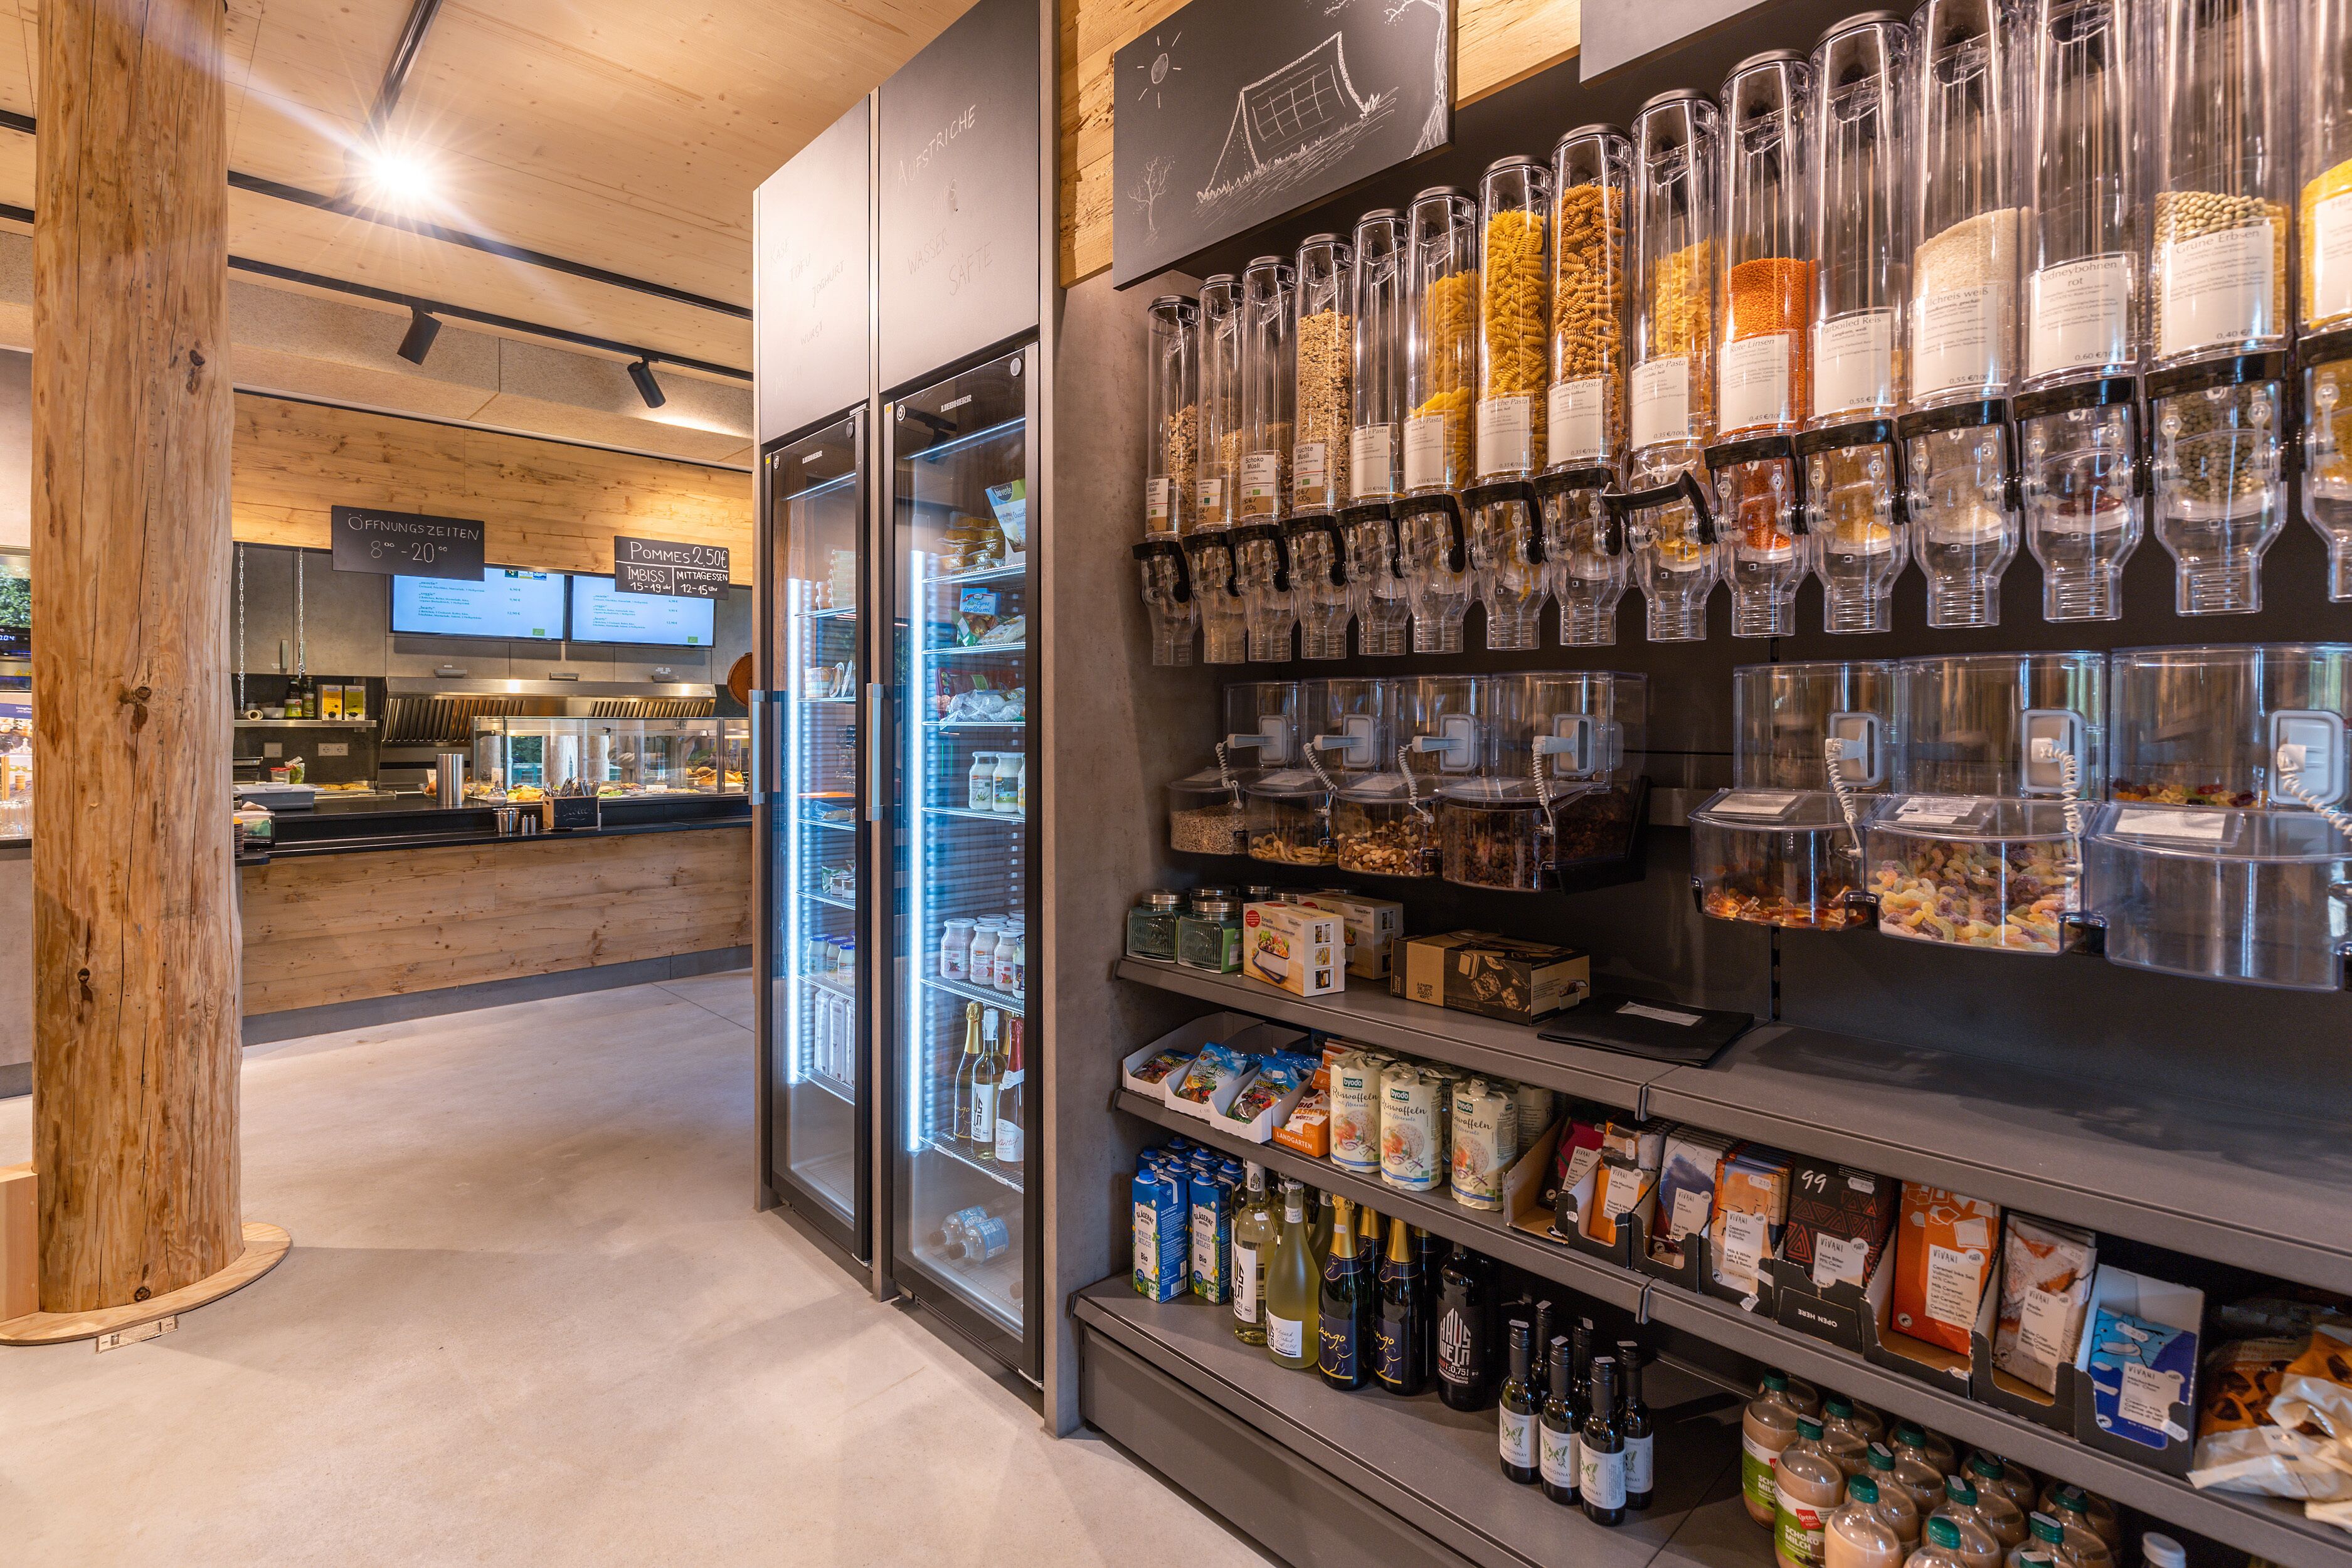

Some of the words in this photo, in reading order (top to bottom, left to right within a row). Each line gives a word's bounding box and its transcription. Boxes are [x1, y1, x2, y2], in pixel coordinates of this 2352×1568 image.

[2218, 230, 2260, 243] Erbsen
[907, 227, 949, 275] WASSER
[949, 241, 993, 296] SÄFTE
[812, 260, 845, 308] JOGHURT
[2068, 278, 2083, 286] rot
[1927, 292, 1961, 306] ilchreis
[1964, 287, 1988, 297] weiß
[1821, 318, 1859, 334] Parboiled
[1863, 316, 1881, 324] Reis
[800, 320, 823, 346] WURST
[1730, 344, 1746, 352] Rote
[1748, 339, 1774, 348] Linsen
[940, 395, 972, 413] LIEBHERR
[1296, 446, 1313, 454] Früchte
[802, 450, 822, 464] LIEBHERR
[348, 513, 479, 541] ÖFFNUNGSZEITEN
[630, 541, 690, 564] POMMES
[627, 566, 665, 583] IMBISS
[677, 571, 728, 581] MITTAGESSEN
[1343, 1078, 1362, 1088] byodo
[1332, 1086, 1379, 1103] Reiswaffeln
[1391, 1089, 1409, 1099] byodo
[1381, 1096, 1428, 1116] Reiswaffeln
[1457, 1101, 1473, 1112] byodo
[1276, 1131, 1312, 1150] LANDGARTEN
[1801, 1170, 1827, 1193] 99
[1136, 1210, 1155, 1224] GLÄSERNE
[1194, 1212, 1214, 1227] GLÄSERNE
[1138, 1229, 1152, 1240] WEIDE
[1729, 1225, 1751, 1234] Cappuccino
[1729, 1229, 1745, 1237] Vollmilch
[1138, 1237, 1152, 1248] MILCH
[1195, 1231, 1210, 1242] WEIDE
[1195, 1239, 1210, 1250] MILCH
[1199, 1254, 1207, 1264] Bio
[1828, 1261, 1842, 1269] Cacao
[1932, 1269, 1953, 1278] Vollmilch
[1933, 1264, 1953, 1273] Caramel
[1942, 1286, 1963, 1295] Caramel
[1941, 1297, 1960, 1305] Caramel
[1798, 1308, 1816, 1320] HERE
[1439, 1307, 1471, 1349] HAUS
[1818, 1315, 1838, 1328] OPEN
[2023, 1327, 2035, 1337] White
[2036, 1333, 2048, 1342] Crisp
[2035, 1345, 2056, 1357] Croccante
[2125, 1397, 2148, 1409] Creamy
[2149, 1405, 2162, 1413] Milk
[1785, 1525, 1819, 1545] SCHOKO
[1785, 1535, 1811, 1551] MILCH
